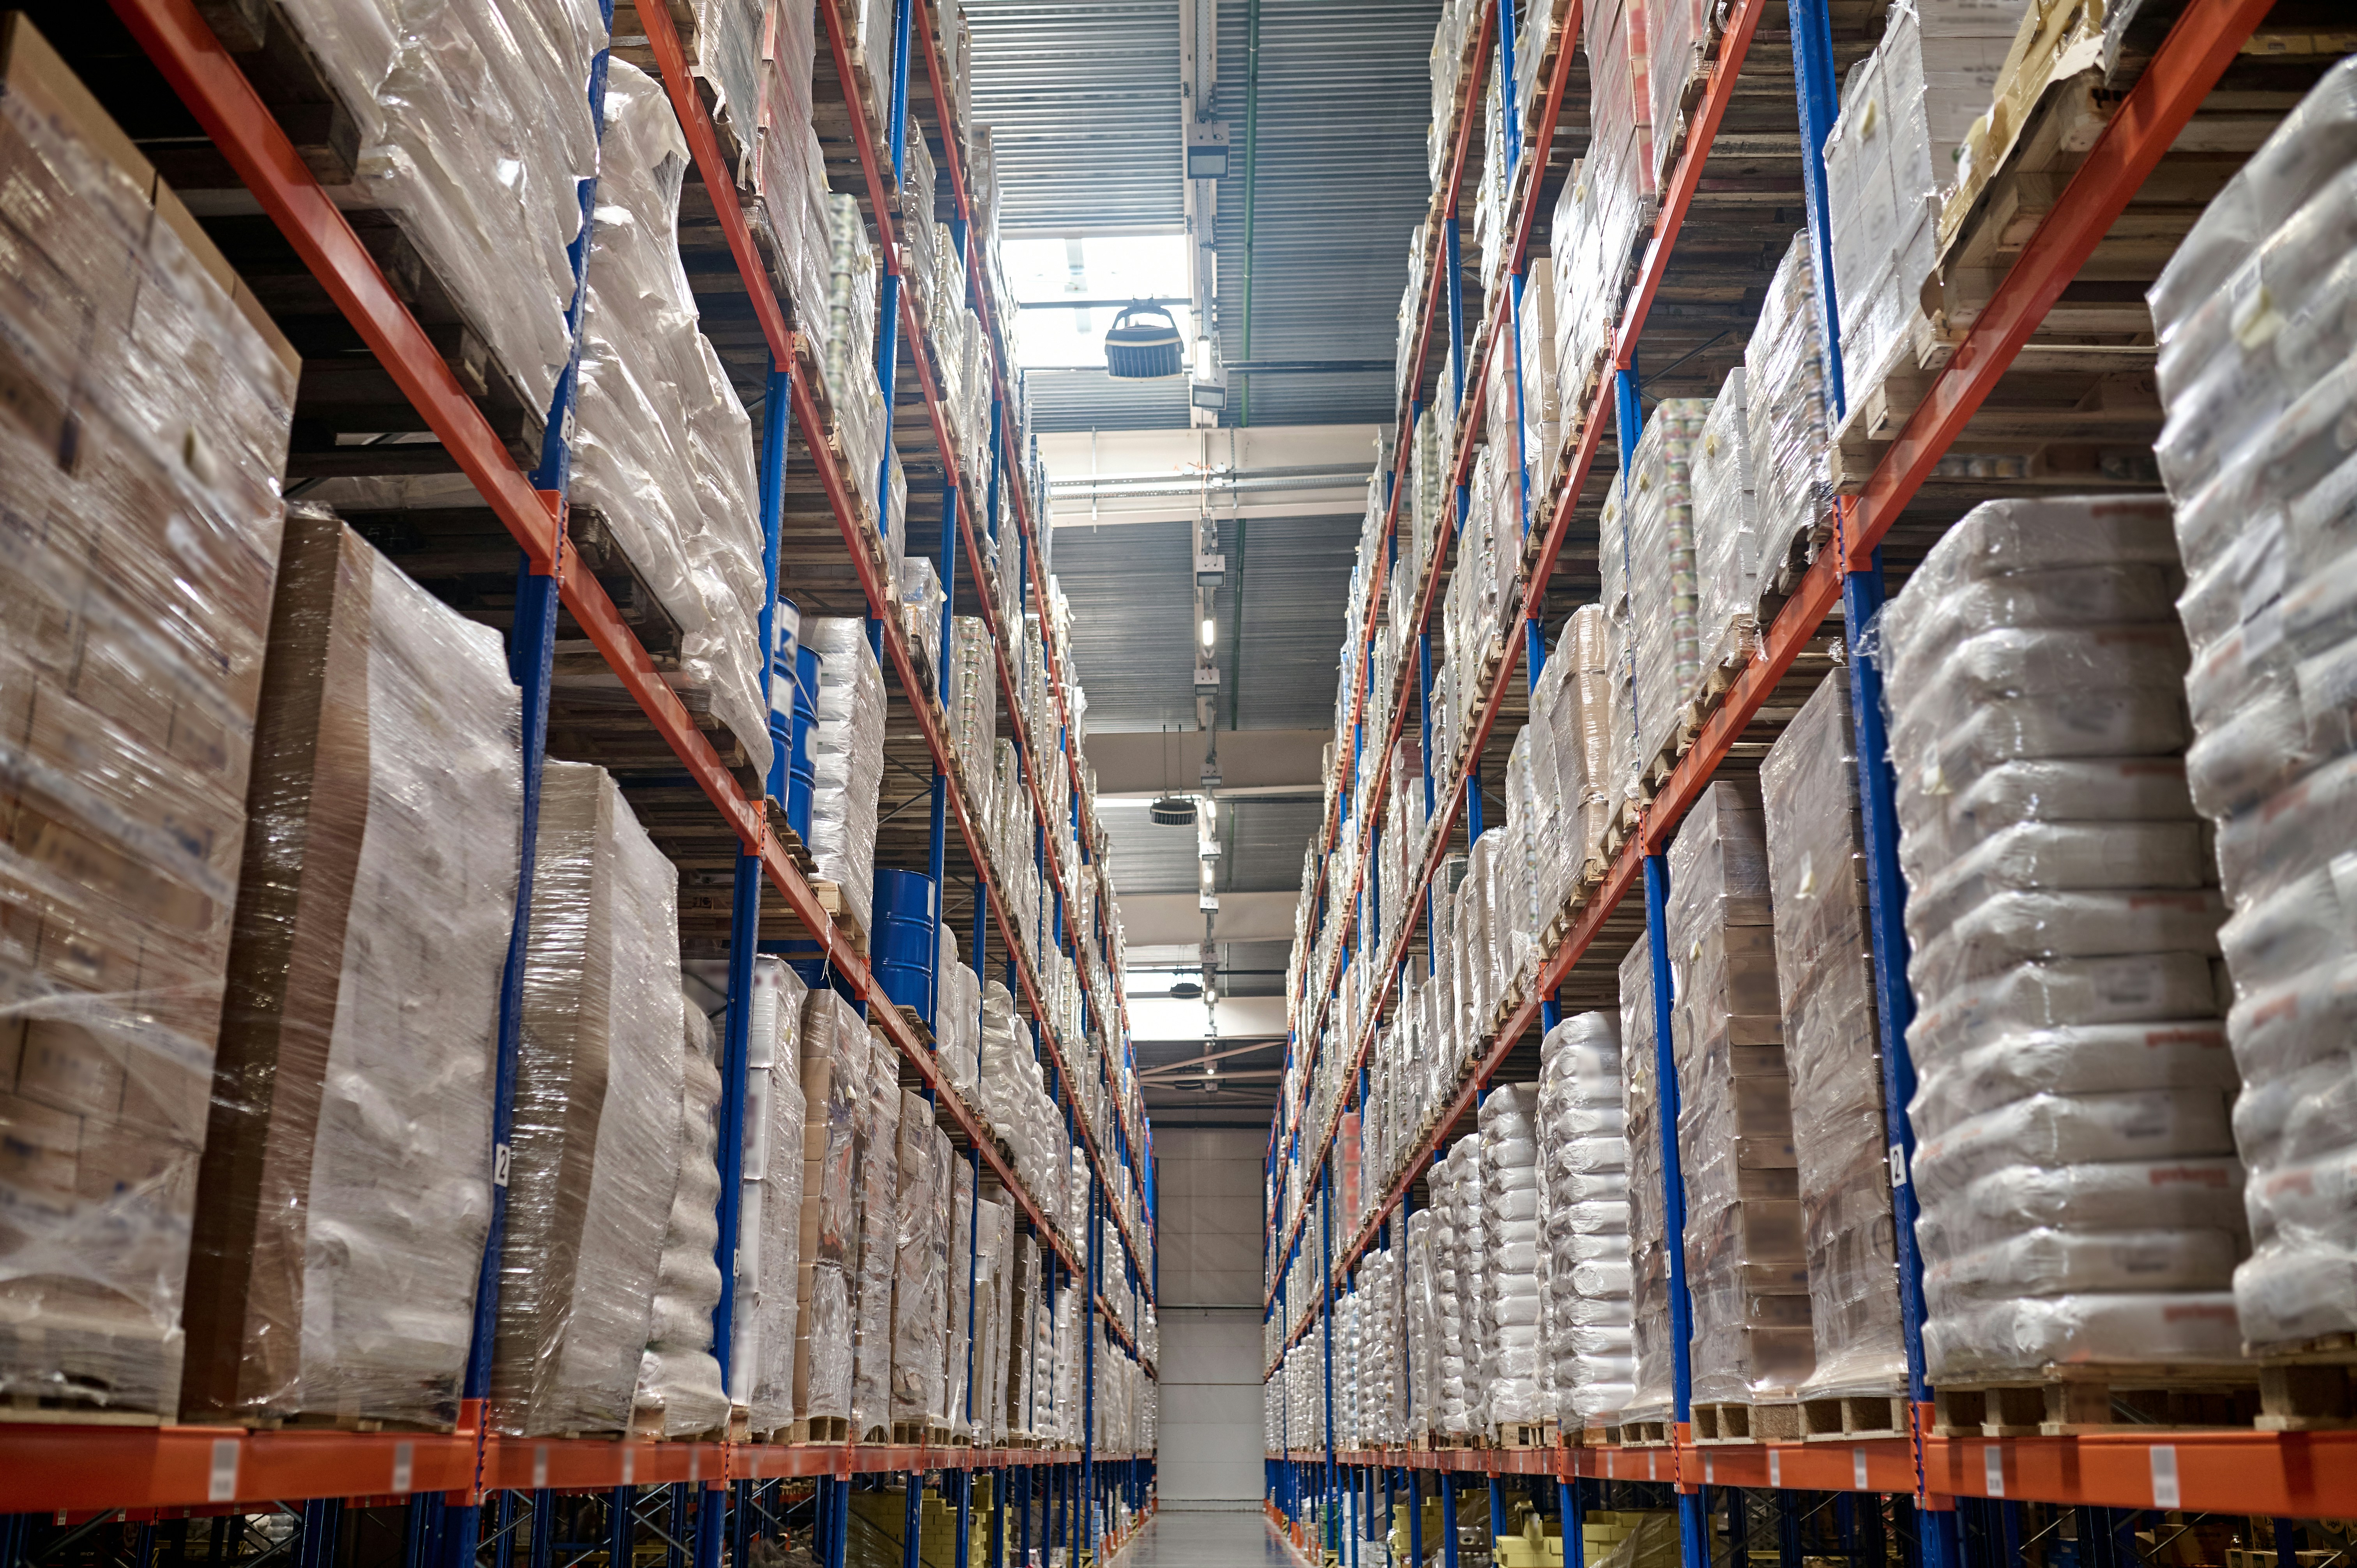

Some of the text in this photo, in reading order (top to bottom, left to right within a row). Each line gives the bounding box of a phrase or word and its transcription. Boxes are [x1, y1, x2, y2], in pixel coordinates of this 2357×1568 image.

[565, 415, 571, 441] 3
[1829, 411, 1835, 436] 3
[1637, 739, 1640, 758] 3
[498, 1150, 506, 1180] 2
[1893, 1150, 1901, 1181] 2
[735, 1253, 739, 1273] 2
[1666, 1254, 1670, 1274] 2
